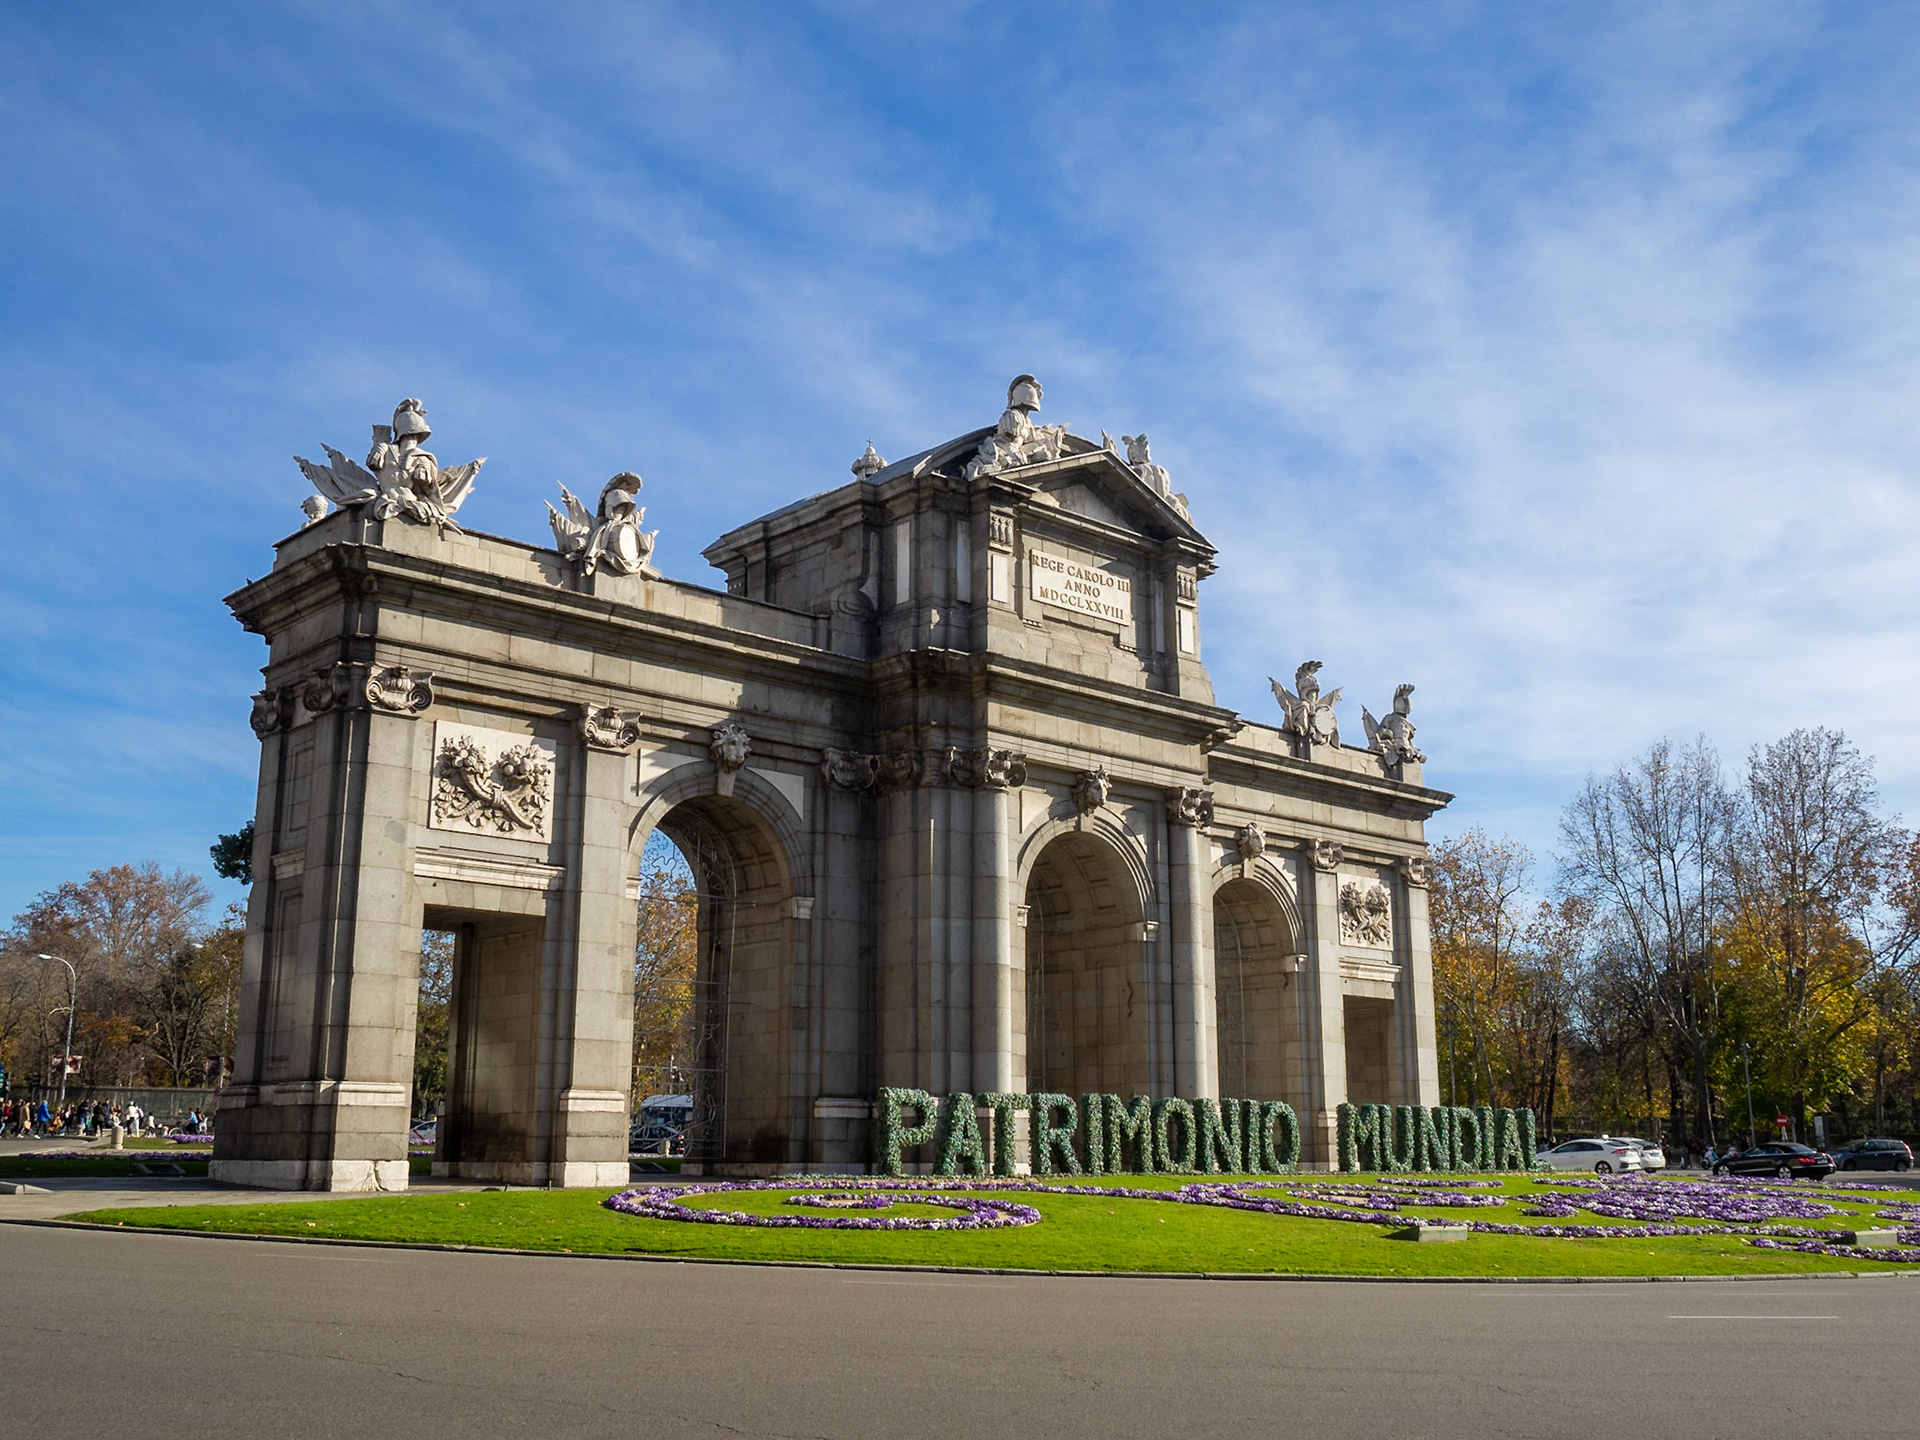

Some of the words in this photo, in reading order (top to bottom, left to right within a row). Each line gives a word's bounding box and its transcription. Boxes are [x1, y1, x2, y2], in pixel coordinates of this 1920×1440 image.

[1032, 554, 1064, 573] REGE
[1067, 565, 1114, 587] CAROLO
[1117, 579, 1130, 593] III
[1065, 579, 1100, 598] ANNO
[1040, 586, 1124, 620] MDCCLXXVIII
[878, 1087, 1301, 1176] PATRIMONIO
[1336, 1103, 1556, 1171] MUNDIAL
